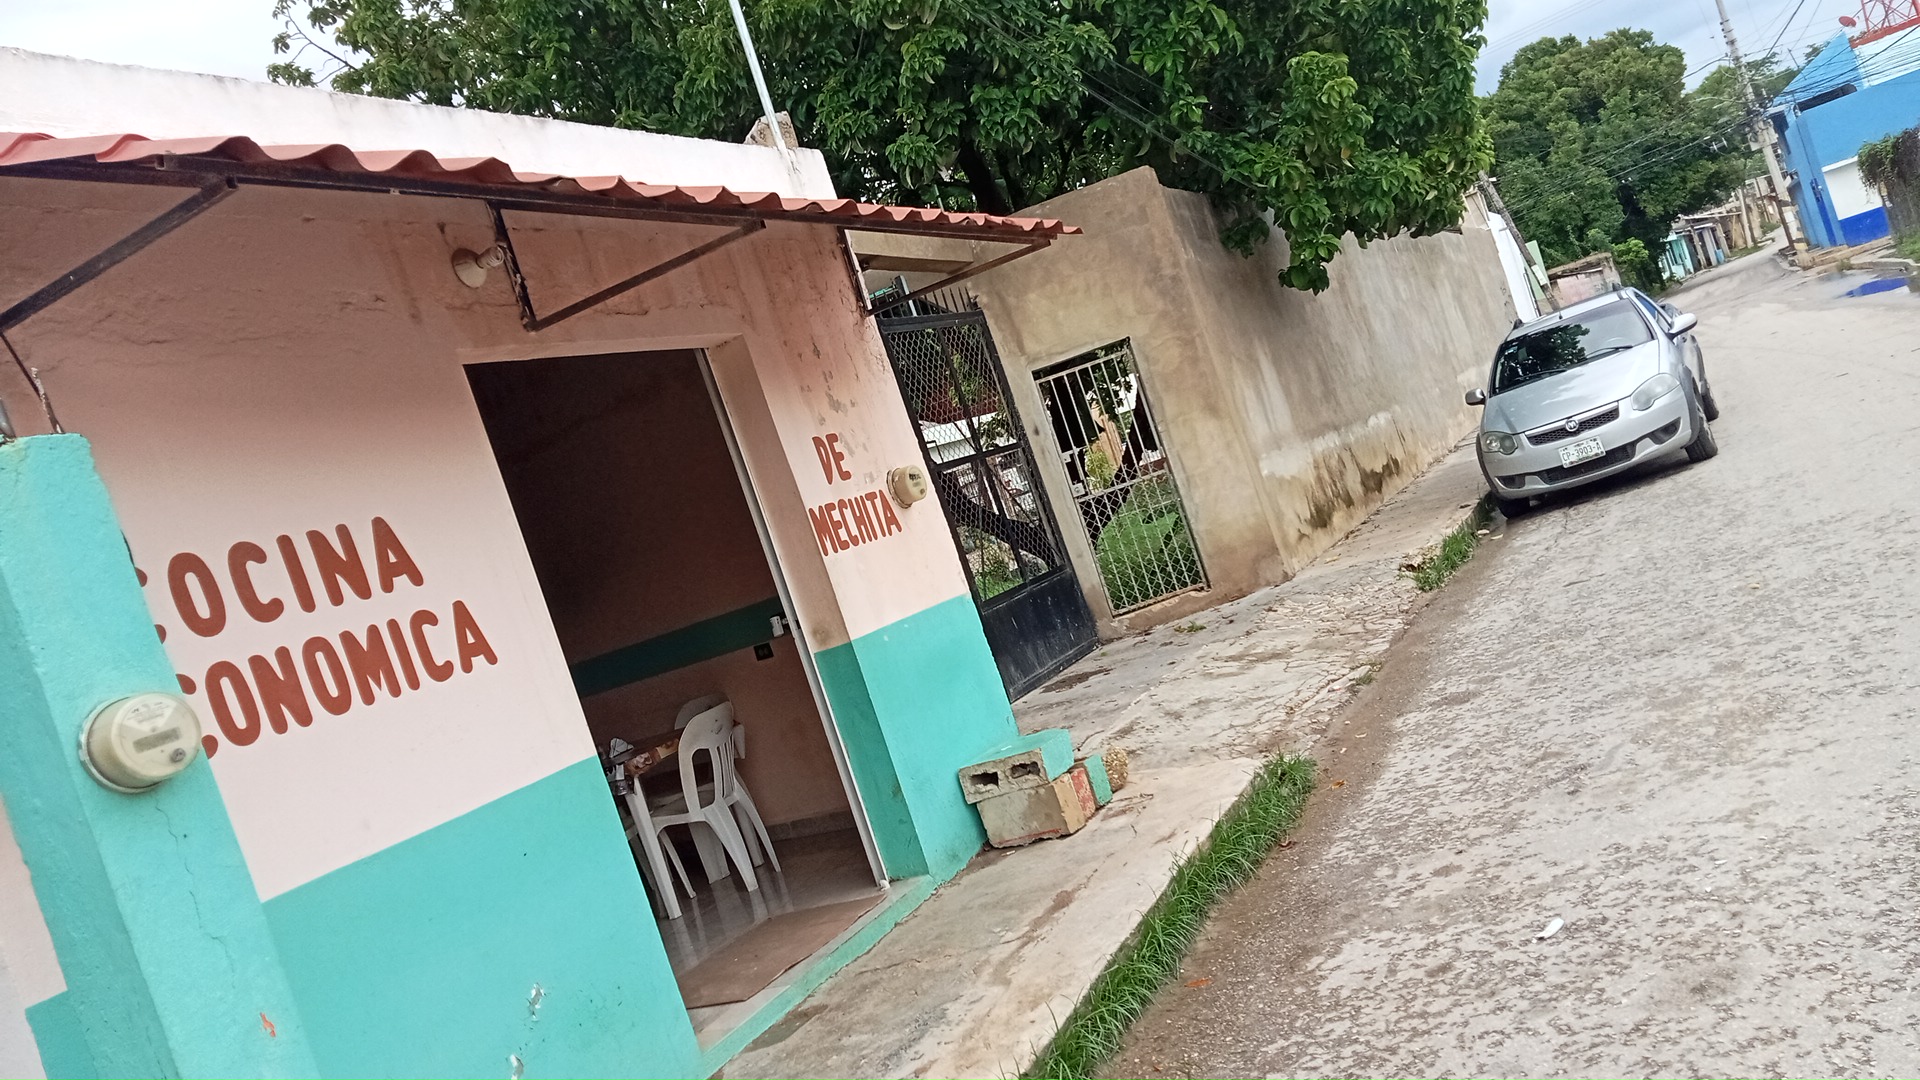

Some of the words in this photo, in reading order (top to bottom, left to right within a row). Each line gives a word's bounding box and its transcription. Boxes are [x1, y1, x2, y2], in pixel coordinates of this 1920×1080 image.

[812, 433, 852, 485] DE
[1561, 442, 1602, 462] CP-3903-A
[808, 490, 903, 557] MECHITA
[133, 516, 424, 644] OCINA
[176, 600, 498, 760] ONOMICA
